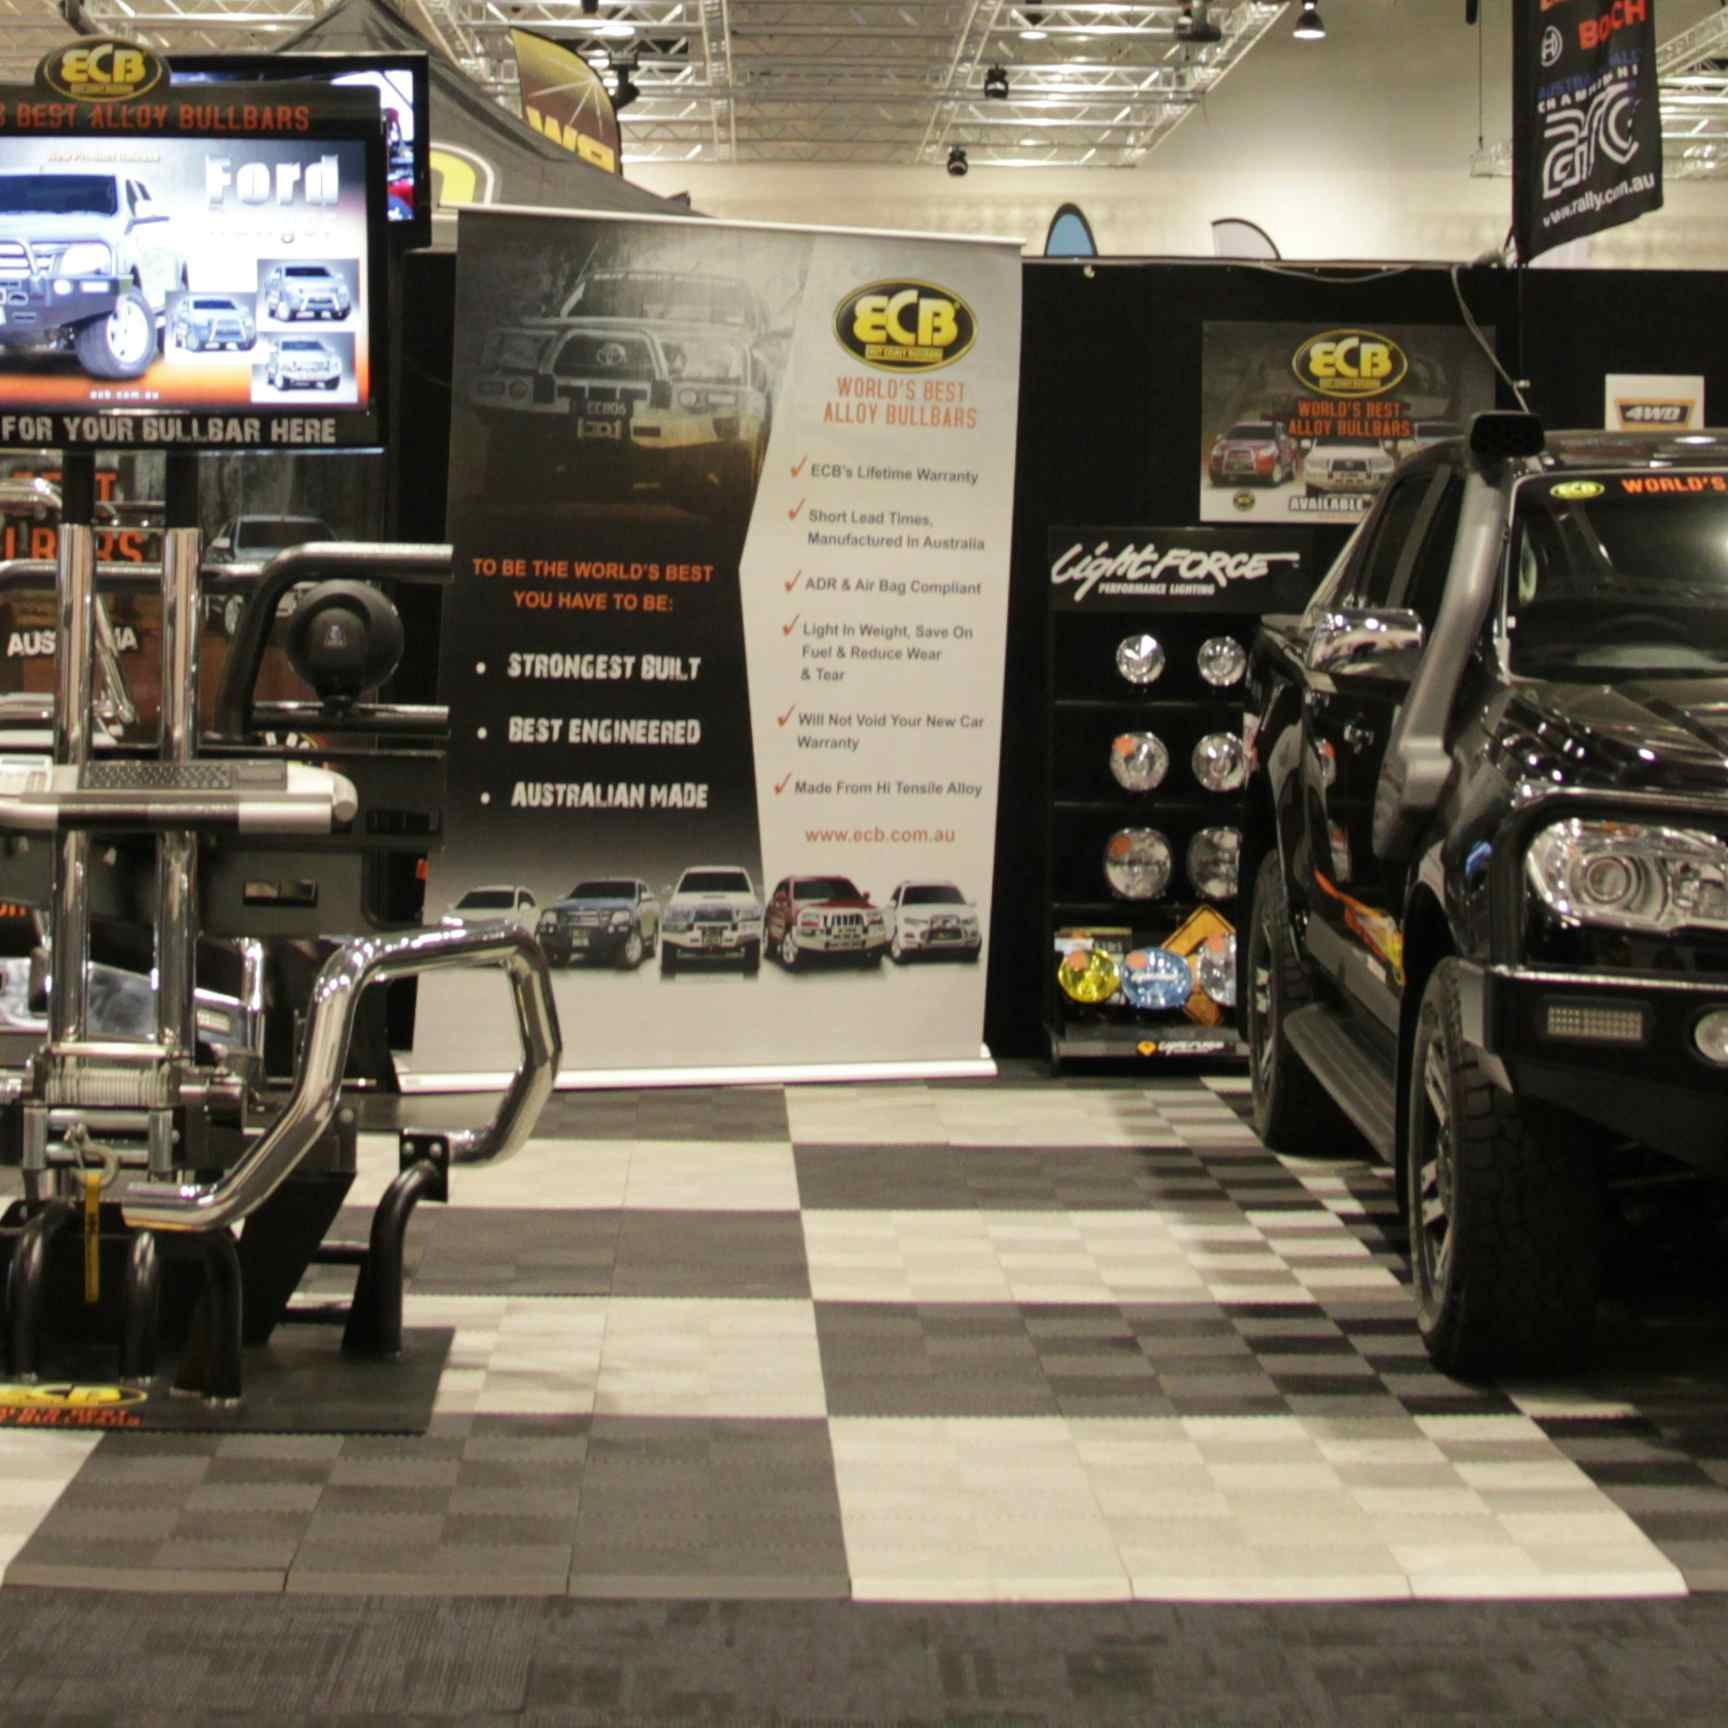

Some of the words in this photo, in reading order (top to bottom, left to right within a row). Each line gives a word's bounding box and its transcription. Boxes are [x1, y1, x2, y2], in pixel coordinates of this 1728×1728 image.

[61, 43, 146, 84] ECB
[16, 103, 78, 129] BEST
[89, 103, 168, 129] ALLOY
[179, 104, 311, 132] BULLBARS
[206, 154, 339, 206] Ford
[853, 288, 959, 347] ECB
[1308, 336, 1393, 378] ECB
[837, 375, 916, 401] WORLD'S
[923, 380, 966, 402] BEST
[824, 400, 879, 425] ALLOY
[886, 404, 977, 430] BULLBARS
[1298, 400, 1361, 417] WORLD'S
[1366, 401, 1401, 416] BEST
[1623, 406, 1680, 421] 4WD
[1, 414, 54, 442] FOR
[62, 415, 136, 443] YOUR
[141, 416, 261, 444] BULLBAR
[270, 417, 336, 444] HERE
[1288, 420, 1330, 436] ALLOY
[1337, 421, 1410, 436] BULLBARS
[810, 462, 854, 480] ECB's
[857, 464, 913, 482] Lifetime
[916, 467, 979, 486] Warranty
[1621, 477, 1726, 495] WORLD'S
[808, 509, 848, 526] Short
[851, 511, 884, 527] Lead
[886, 512, 934, 530] Times,
[807, 531, 902, 550] Manufactured
[905, 534, 920, 549] In
[924, 535, 986, 552] Australia
[472, 559, 497, 577] TO
[501, 560, 528, 578] BE
[532, 560, 570, 579] THE
[574, 561, 660, 582] WORLD'S
[665, 564, 714, 582] BEST
[805, 576, 838, 592] ADR
[841, 578, 852, 592] &
[854, 578, 875, 594] Air
[878, 579, 906, 597] Bag
[908, 579, 982, 598] Compliant
[1098, 583, 1166, 596] PERFORMANCE
[1169, 584, 1215, 596] LIGHTING
[513, 591, 554, 609] YOU
[558, 592, 606, 611] HAVE
[610, 592, 638, 611] TO
[642, 593, 673, 612] BE:
[7, 626, 137, 658] AUSIA
[802, 622, 838, 641] Light
[842, 623, 856, 638] In
[859, 623, 912, 642] Weight,
[915, 624, 949, 639] Save
[952, 625, 973, 640] On
[801, 644, 833, 660] Fuel
[836, 646, 847, 660] &
[850, 645, 901, 661] Reduce
[904, 647, 943, 662] Wear
[507, 653, 634, 679] STRONGEST
[641, 654, 702, 681] BUILT
[800, 667, 813, 681] &
[816, 667, 845, 682] Tear
[508, 716, 563, 743] BEST
[568, 717, 701, 745] ENGINEERED
[798, 712, 824, 728] Will
[828, 713, 853, 728] Not
[856, 713, 886, 729] Void
[889, 713, 922, 729] Your
[924, 714, 954, 729] New
[958, 714, 984, 730] Car
[796, 735, 859, 753] Warranty
[511, 781, 645, 808] AUSTRALIAN
[650, 782, 708, 809] MADE
[794, 780, 832, 796] Made
[836, 781, 873, 796] From
[876, 781, 891, 796] Hi
[895, 781, 943, 796] Tensile
[946, 781, 983, 799] Alloy
[805, 826, 956, 844] www.ecb.com.au
